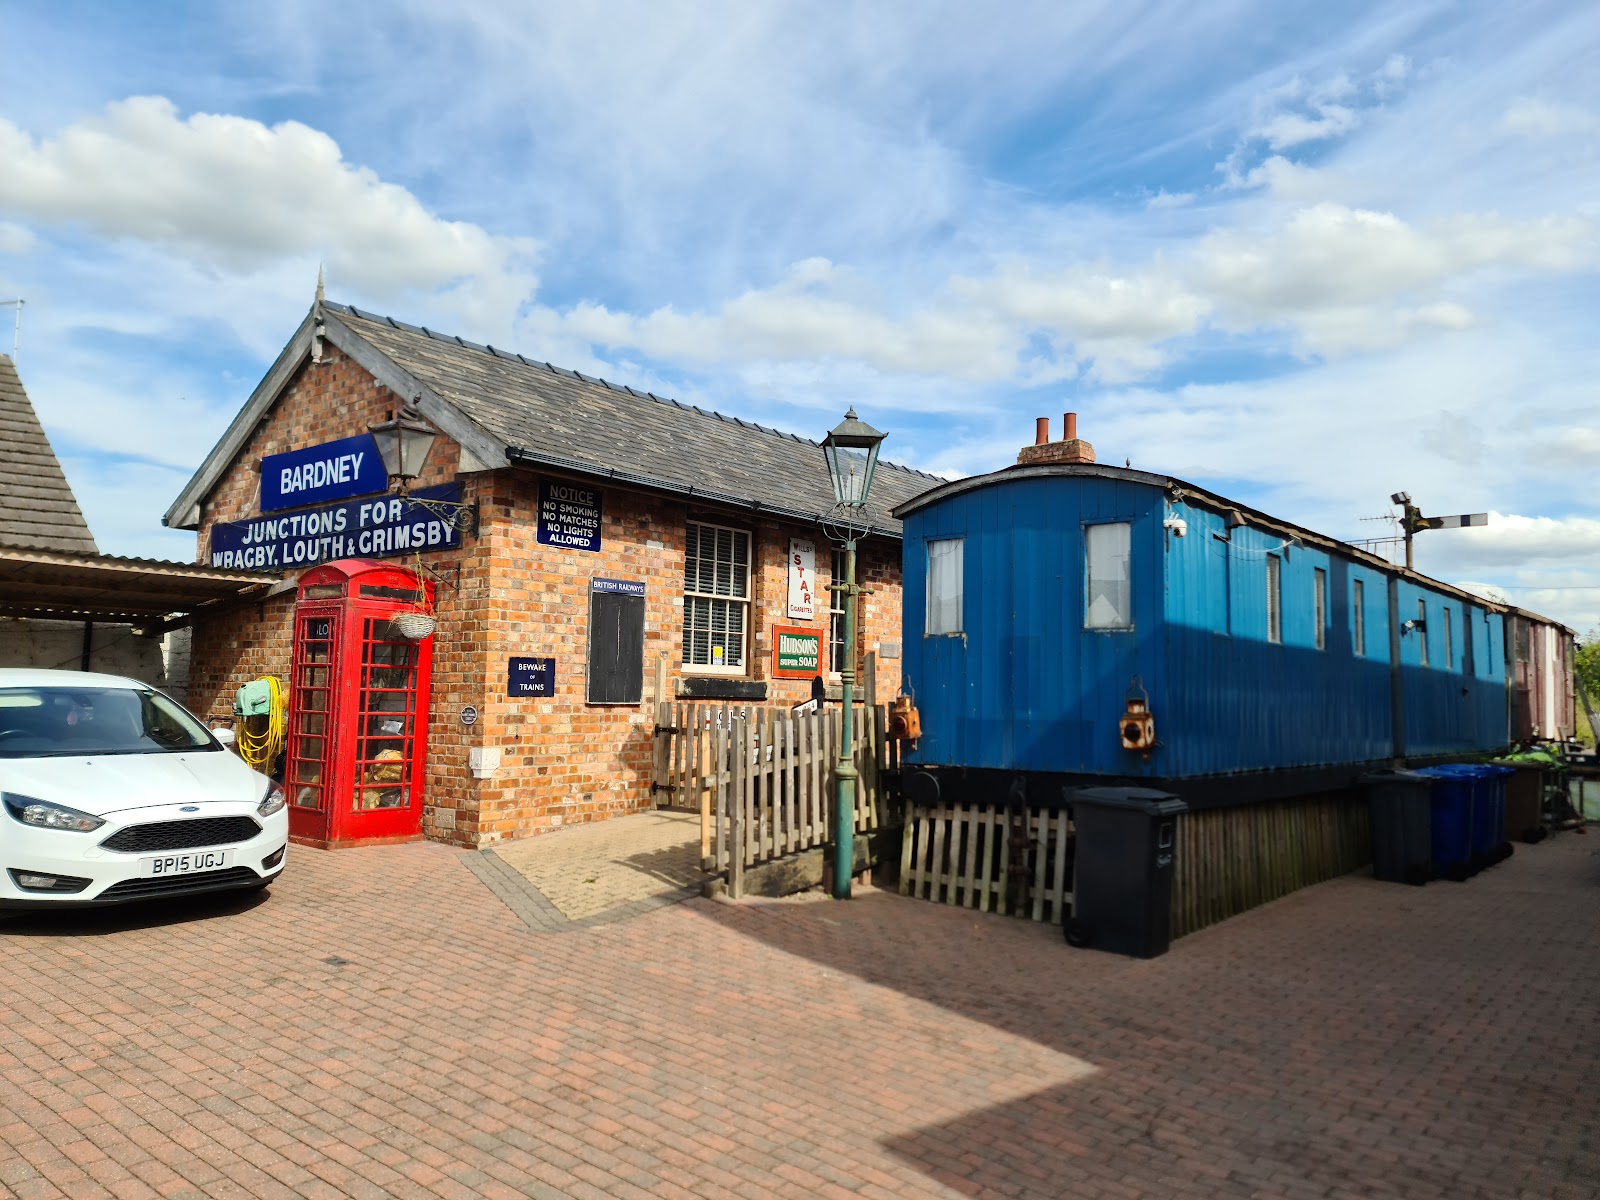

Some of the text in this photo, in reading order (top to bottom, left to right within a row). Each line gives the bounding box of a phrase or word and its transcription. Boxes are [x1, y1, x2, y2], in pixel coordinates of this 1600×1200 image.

[280, 452, 364, 495] BARDNEY
[550, 485, 594, 504] NOTICE
[543, 501, 599, 518] NO SMOKING
[242, 499, 402, 544] JUNCTIONS FOR
[543, 511, 598, 528] NO MATCHES
[547, 522, 594, 538] NO LIGHTS
[283, 536, 344, 564] LOUTH
[358, 520, 454, 551] GRIMSBY
[593, 581, 644, 593] BRITISH RAILWAYS
[780, 635, 818, 655] HUDSON'S
[780, 657, 818, 668] SUPER SOAP
[152, 852, 225, 874] BP15 UGJ
